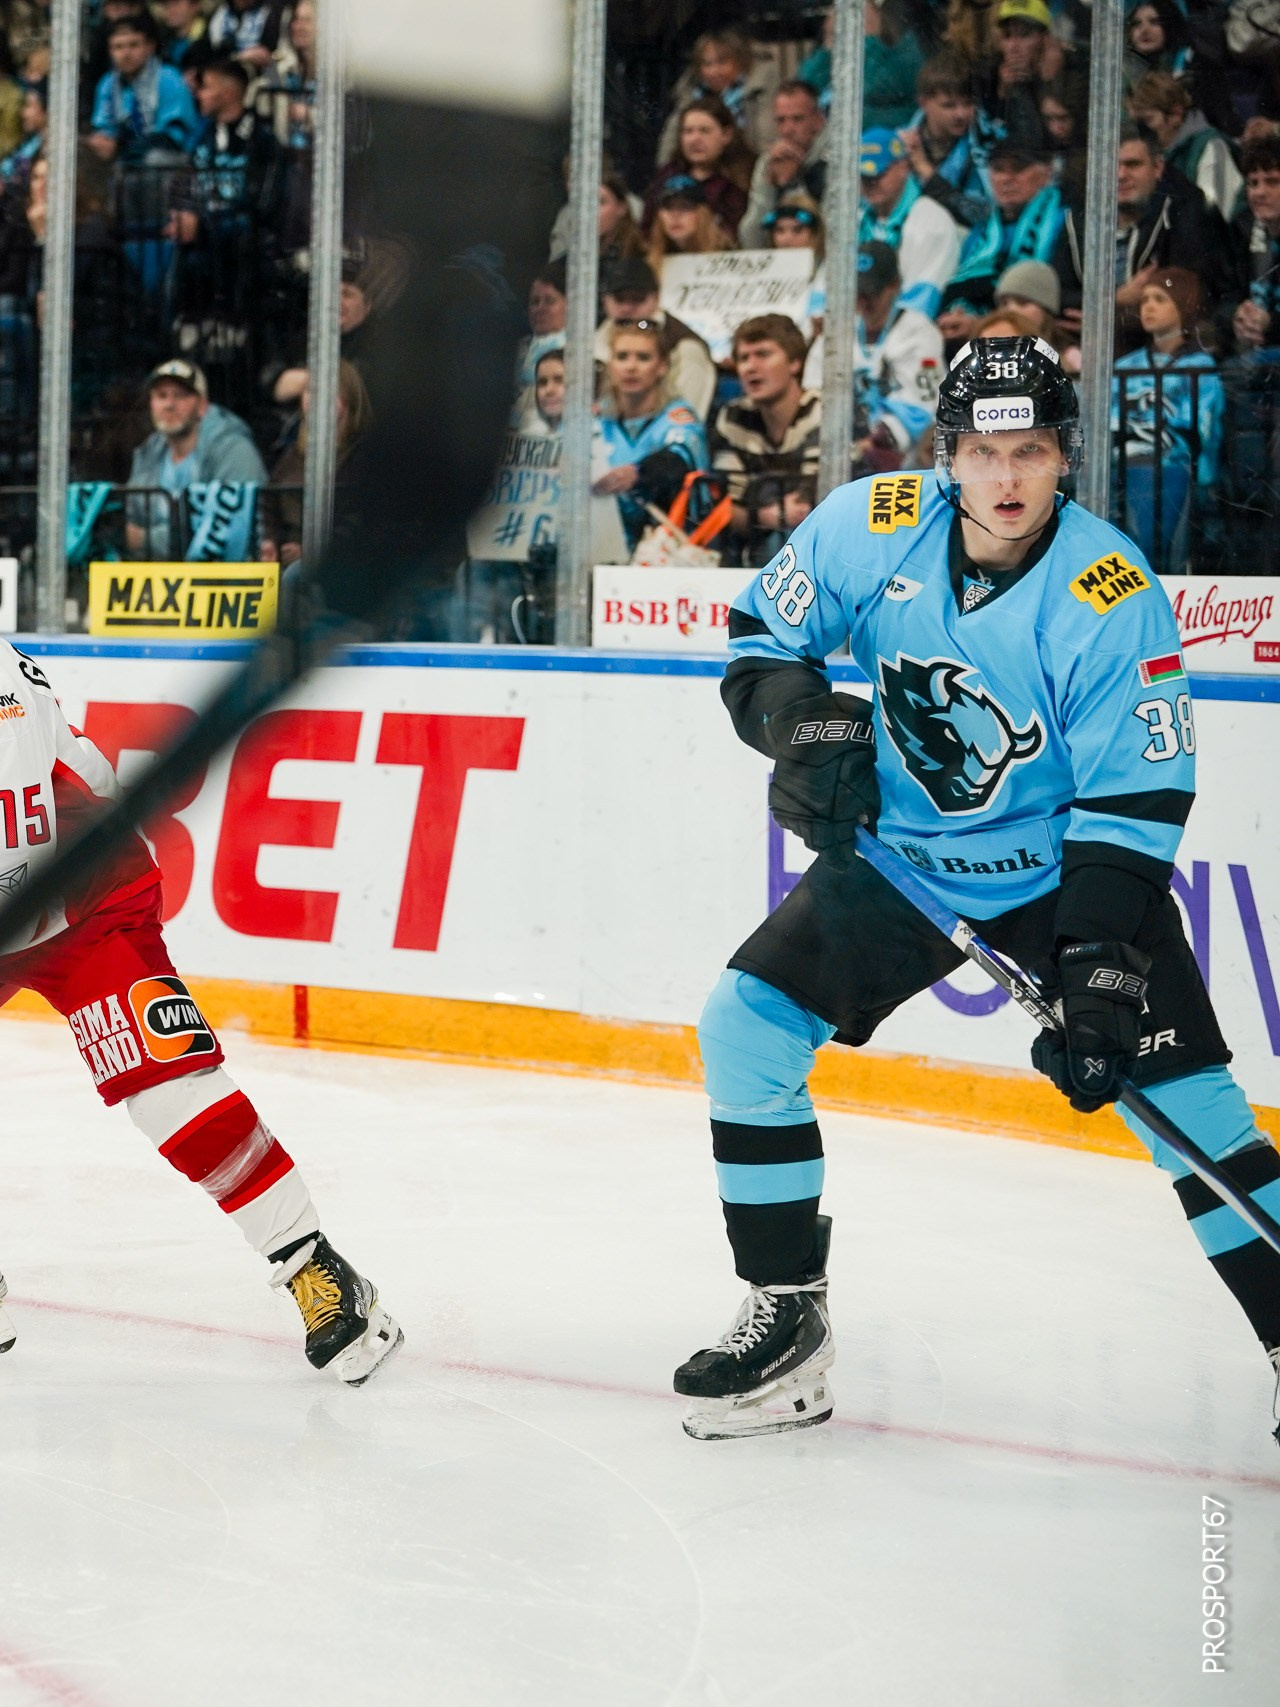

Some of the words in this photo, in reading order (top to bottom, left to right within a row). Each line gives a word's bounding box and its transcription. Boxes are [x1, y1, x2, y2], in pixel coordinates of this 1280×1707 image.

[986, 361, 1019, 380] 38
[976, 407, 1031, 421] согаз
[872, 482, 895, 525] LINE
[894, 478, 917, 518] MAX
[761, 543, 817, 627] 38
[1077, 556, 1128, 594] MAX
[1097, 569, 1146, 606] LINE
[107, 577, 183, 613] MAX
[184, 591, 263, 628] LINE
[603, 599, 669, 625] BSB
[1132, 692, 1197, 763] 38
[935, 847, 1048, 875] Bank
[69, 993, 131, 1050] SIMA
[157, 1003, 202, 1029] WIN
[761, 1345, 797, 1379] BAUER
